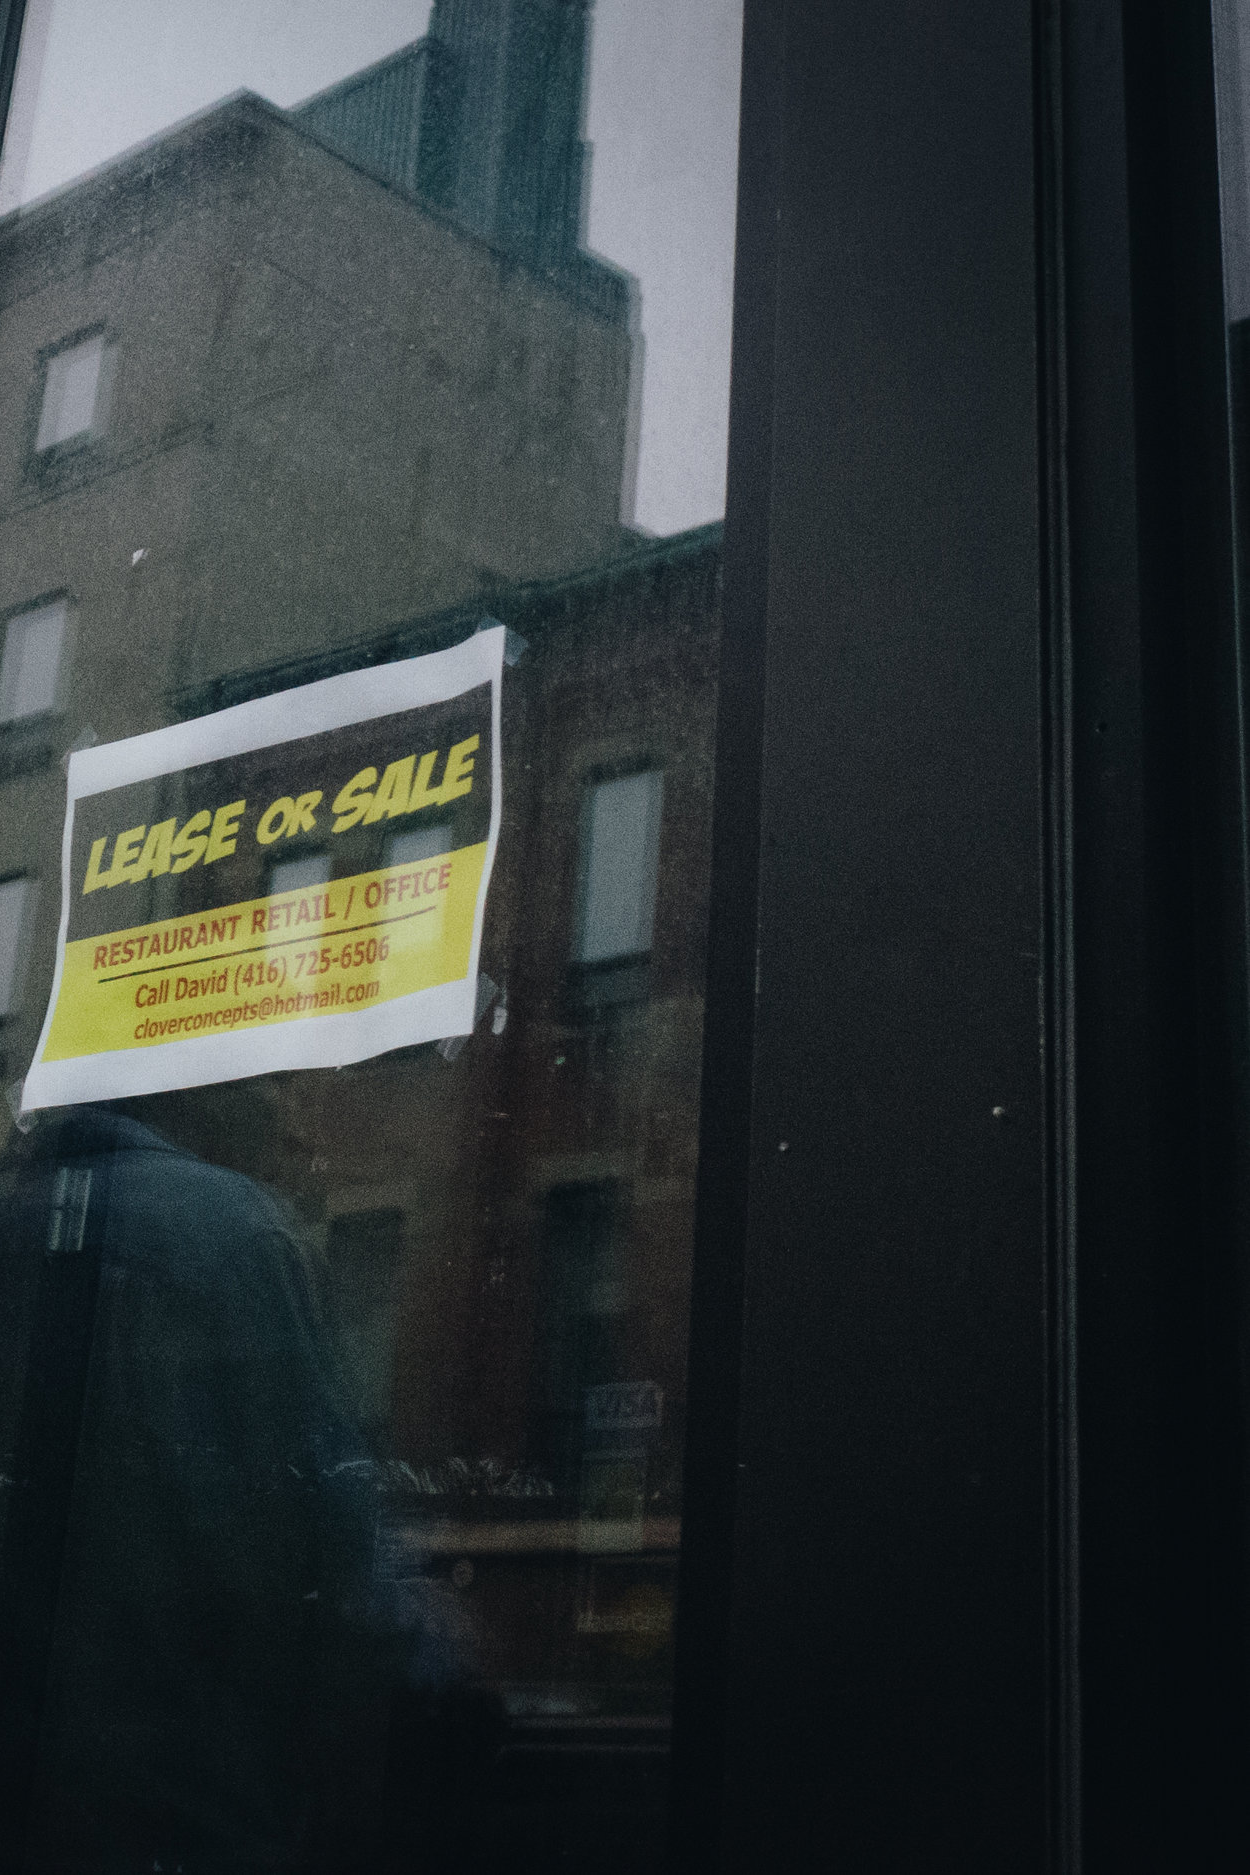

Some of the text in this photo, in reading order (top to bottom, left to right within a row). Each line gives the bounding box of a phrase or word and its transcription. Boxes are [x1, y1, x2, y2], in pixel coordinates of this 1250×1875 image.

[82, 733, 480, 896] LEASE OR SALE
[92, 863, 453, 971] RESTAURANT RETAIL / OFFICE
[133, 979, 381, 1041] cloverconcepts@hotmail.com
[134, 935, 390, 1009] Call David (416) 725-6506
